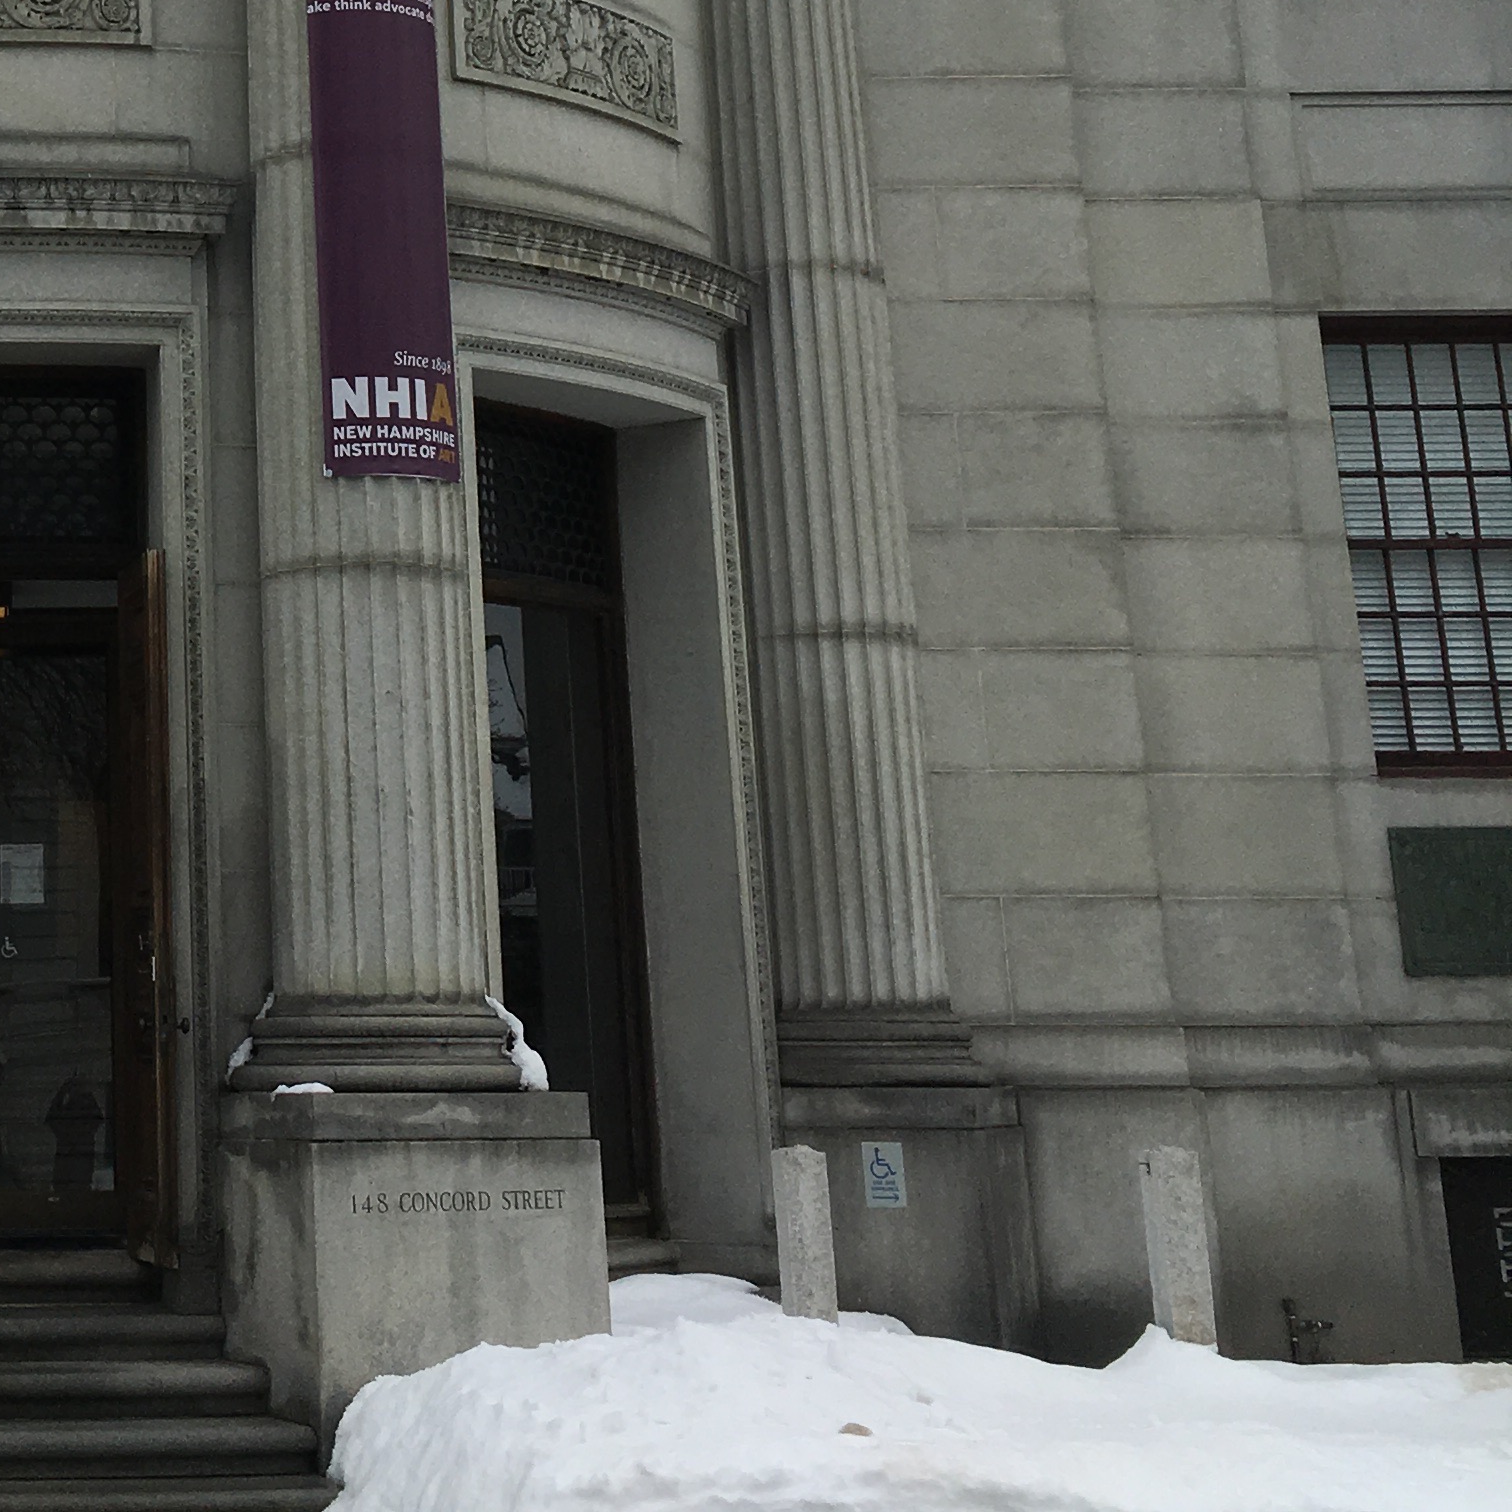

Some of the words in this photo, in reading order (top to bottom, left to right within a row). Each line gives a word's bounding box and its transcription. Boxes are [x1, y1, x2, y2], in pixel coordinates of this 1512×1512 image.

[375, 0, 424, 19] advocate
[394, 351, 428, 368] Since
[332, 377, 453, 426] NHIA
[334, 426, 372, 440] NEW
[377, 425, 454, 447] HAMPSHIRE
[334, 443, 417, 457] INSTITUTE
[420, 445, 436, 458] OF
[352, 1193, 388, 1213] 148
[400, 1192, 491, 1213] CONCORD
[502, 1190, 565, 1210] STREET
